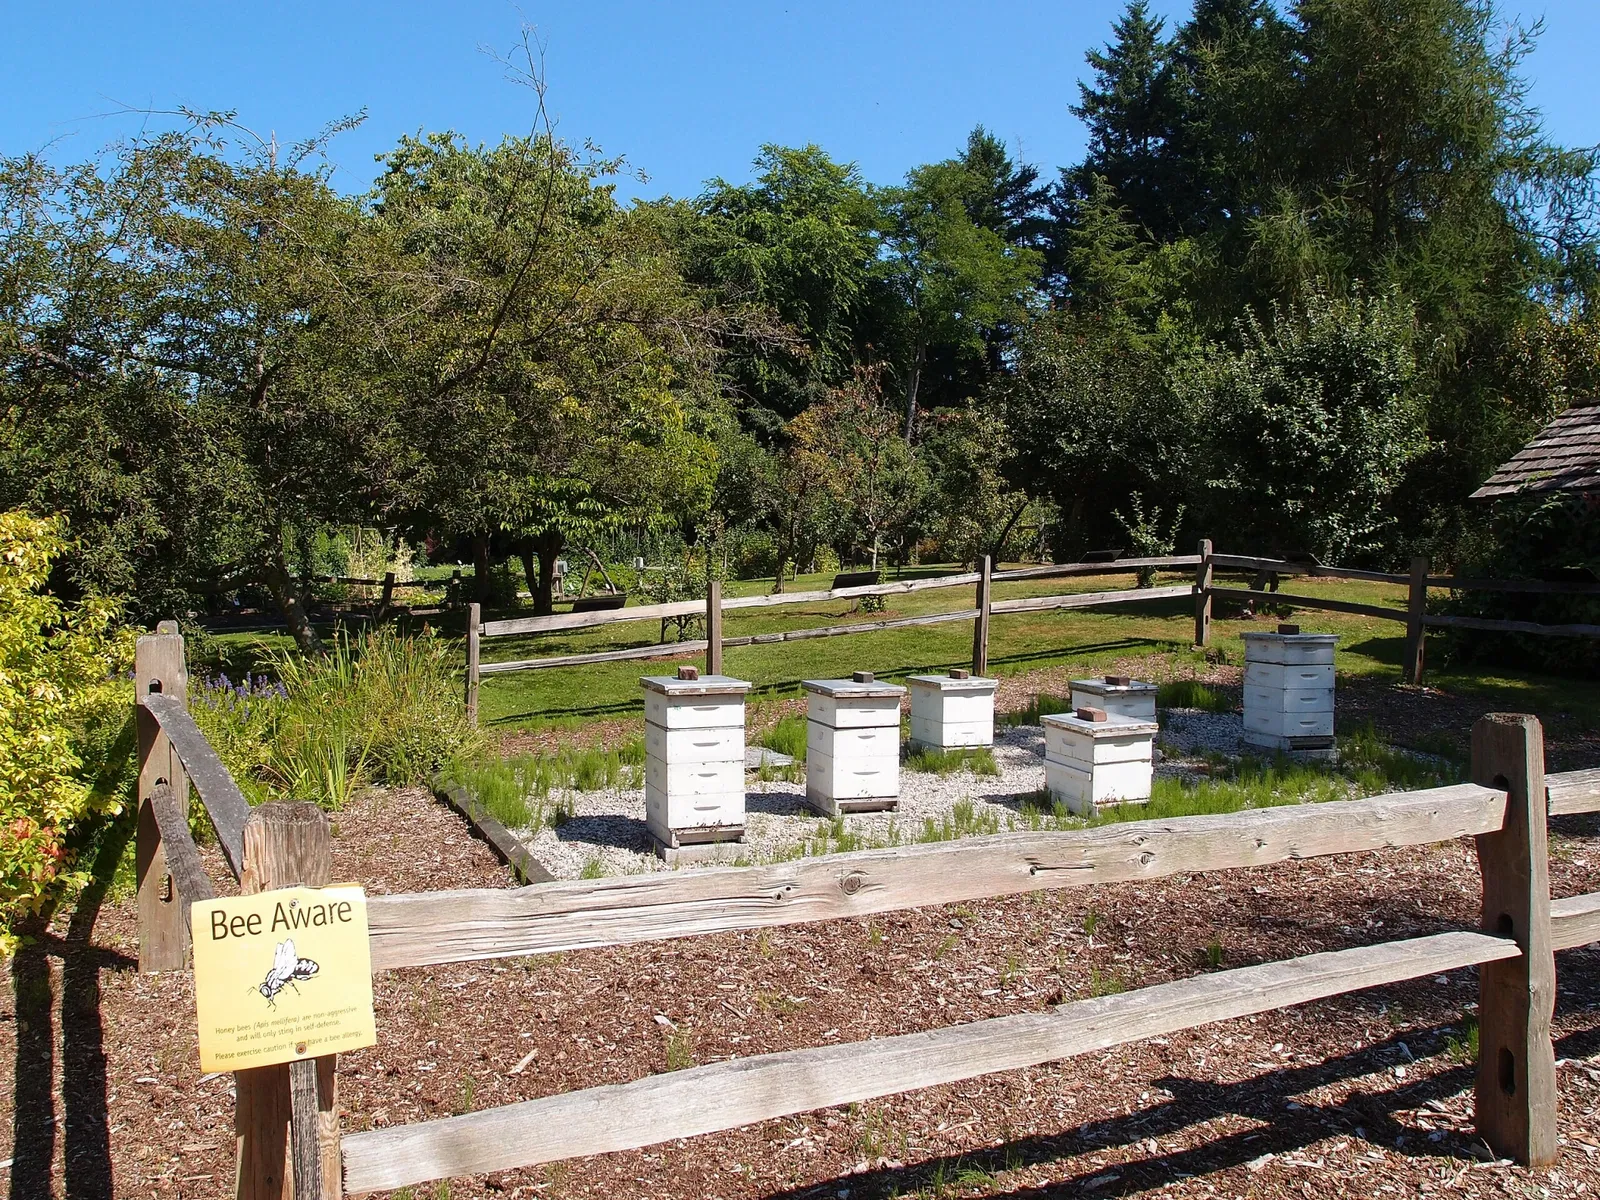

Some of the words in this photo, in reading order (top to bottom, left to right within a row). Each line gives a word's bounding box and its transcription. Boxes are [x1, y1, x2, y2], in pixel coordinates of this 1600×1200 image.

[211, 909, 262, 940] Bee
[271, 901, 352, 932] Aware
[236, 1034, 248, 1042] and
[250, 1031, 261, 1040] will
[263, 1029, 276, 1038] only
[278, 1026, 294, 1035] sting
[303, 1020, 341, 1031] self-defense.
[237, 1024, 251, 1032] bees
[253, 1020, 269, 1031] (Apis
[313, 1006, 357, 1018] non-aggressive
[215, 1052, 235, 1060] Please
[237, 1048, 261, 1057] exercise
[263, 1043, 287, 1052] caution
[307, 1037, 322, 1046] have
[342, 1031, 363, 1039] allergy.
